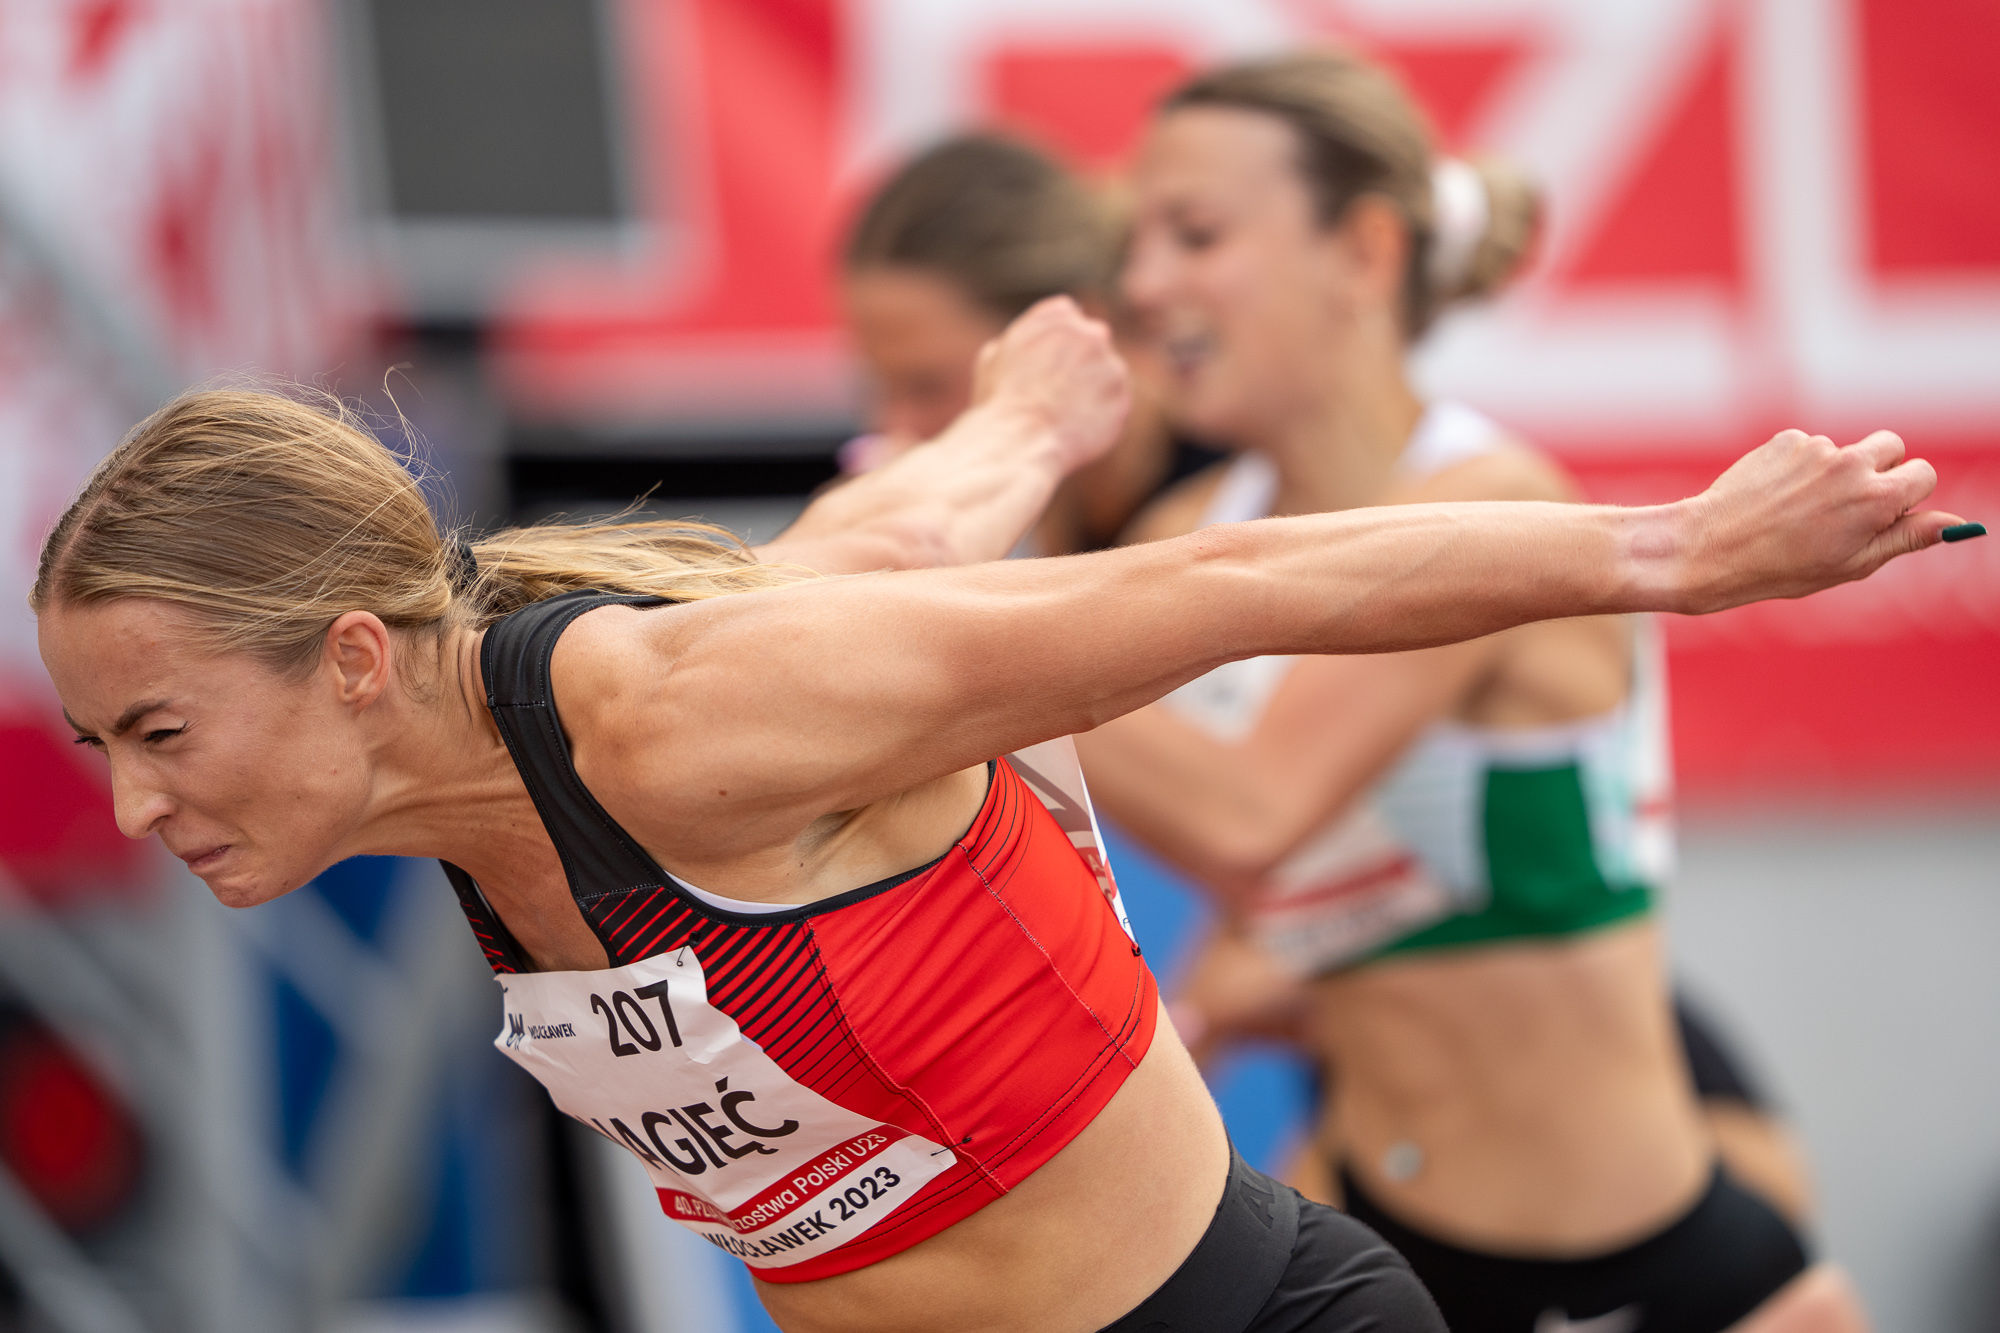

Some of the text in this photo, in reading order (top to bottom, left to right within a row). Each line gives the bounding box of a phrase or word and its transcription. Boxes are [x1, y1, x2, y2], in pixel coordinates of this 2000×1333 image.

[590, 979, 682, 1057] 207
[792, 1151, 853, 1194] Polski
[845, 1133, 888, 1157] U23
[829, 1166, 900, 1221] 2023
